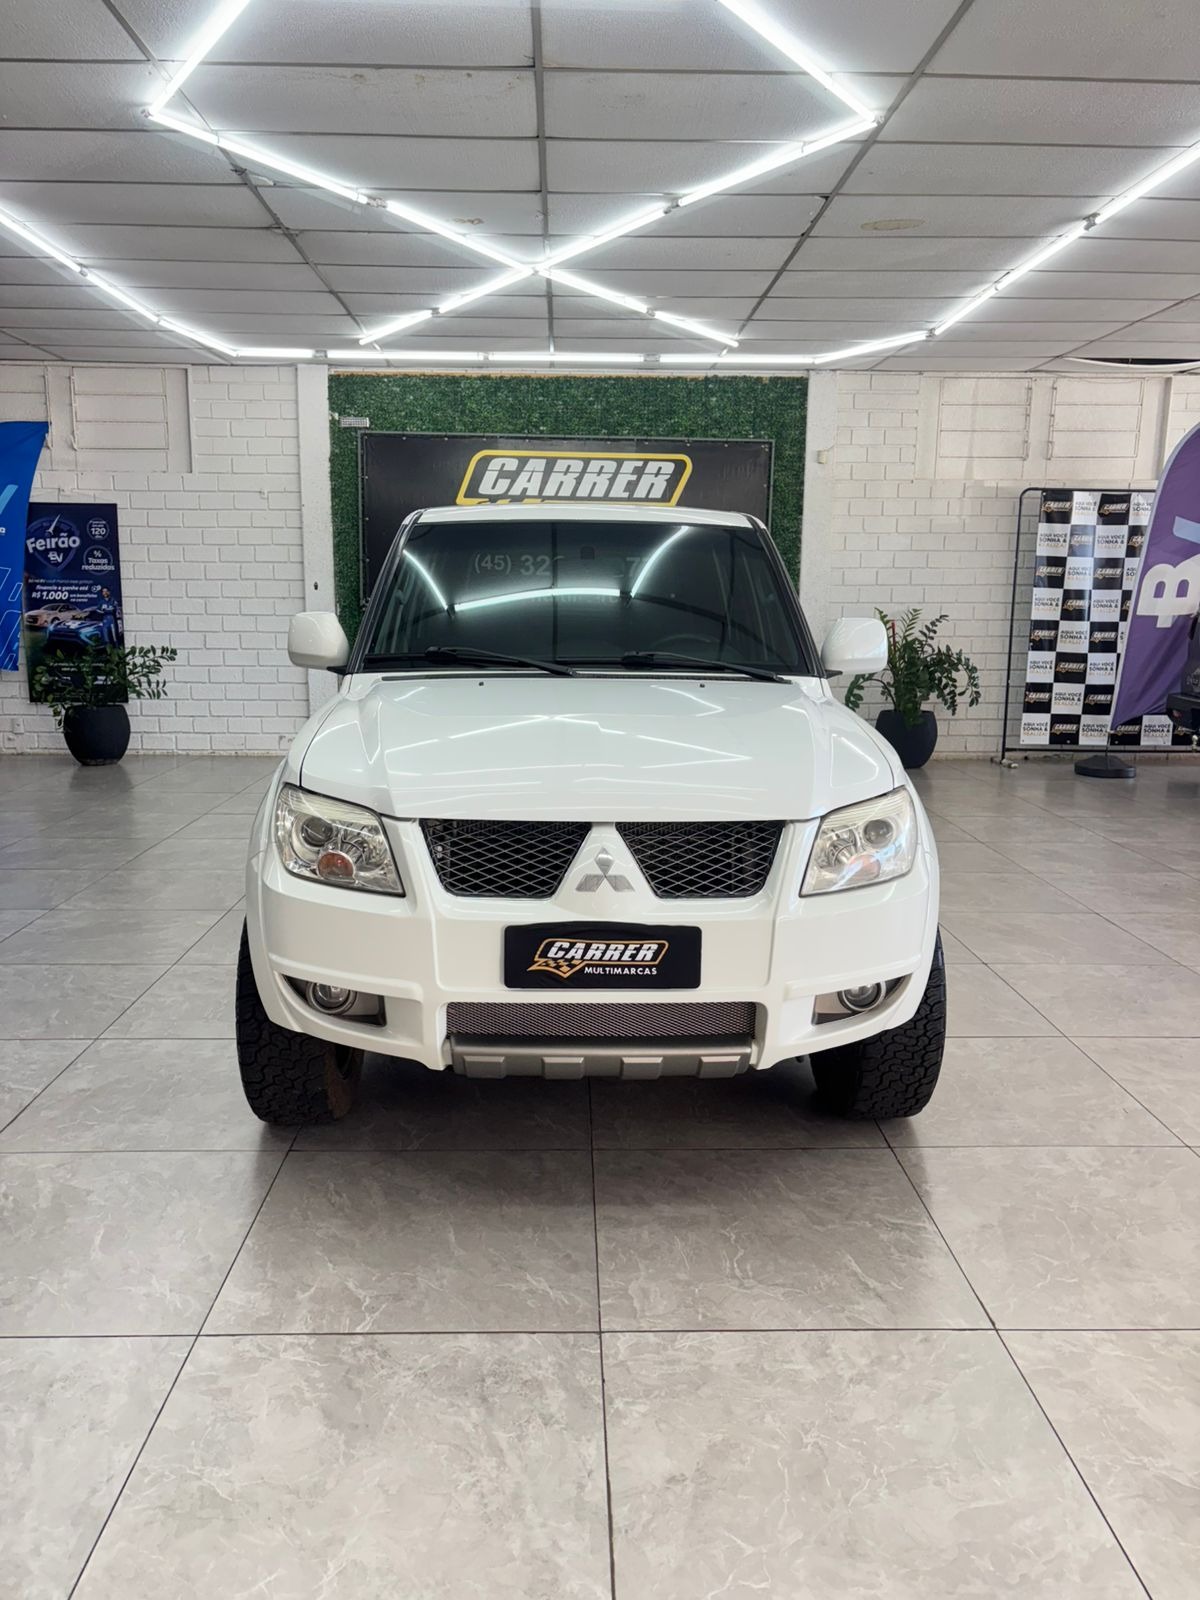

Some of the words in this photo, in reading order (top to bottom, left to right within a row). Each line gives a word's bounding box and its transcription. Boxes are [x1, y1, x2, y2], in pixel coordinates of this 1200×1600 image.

[478, 458, 676, 499] CARRER
[26, 533, 80, 553] Feirão
[42, 591, 68, 600] 1.000
[547, 941, 659, 962] CARRER
[584, 966, 658, 975] MULTIMARCAS
